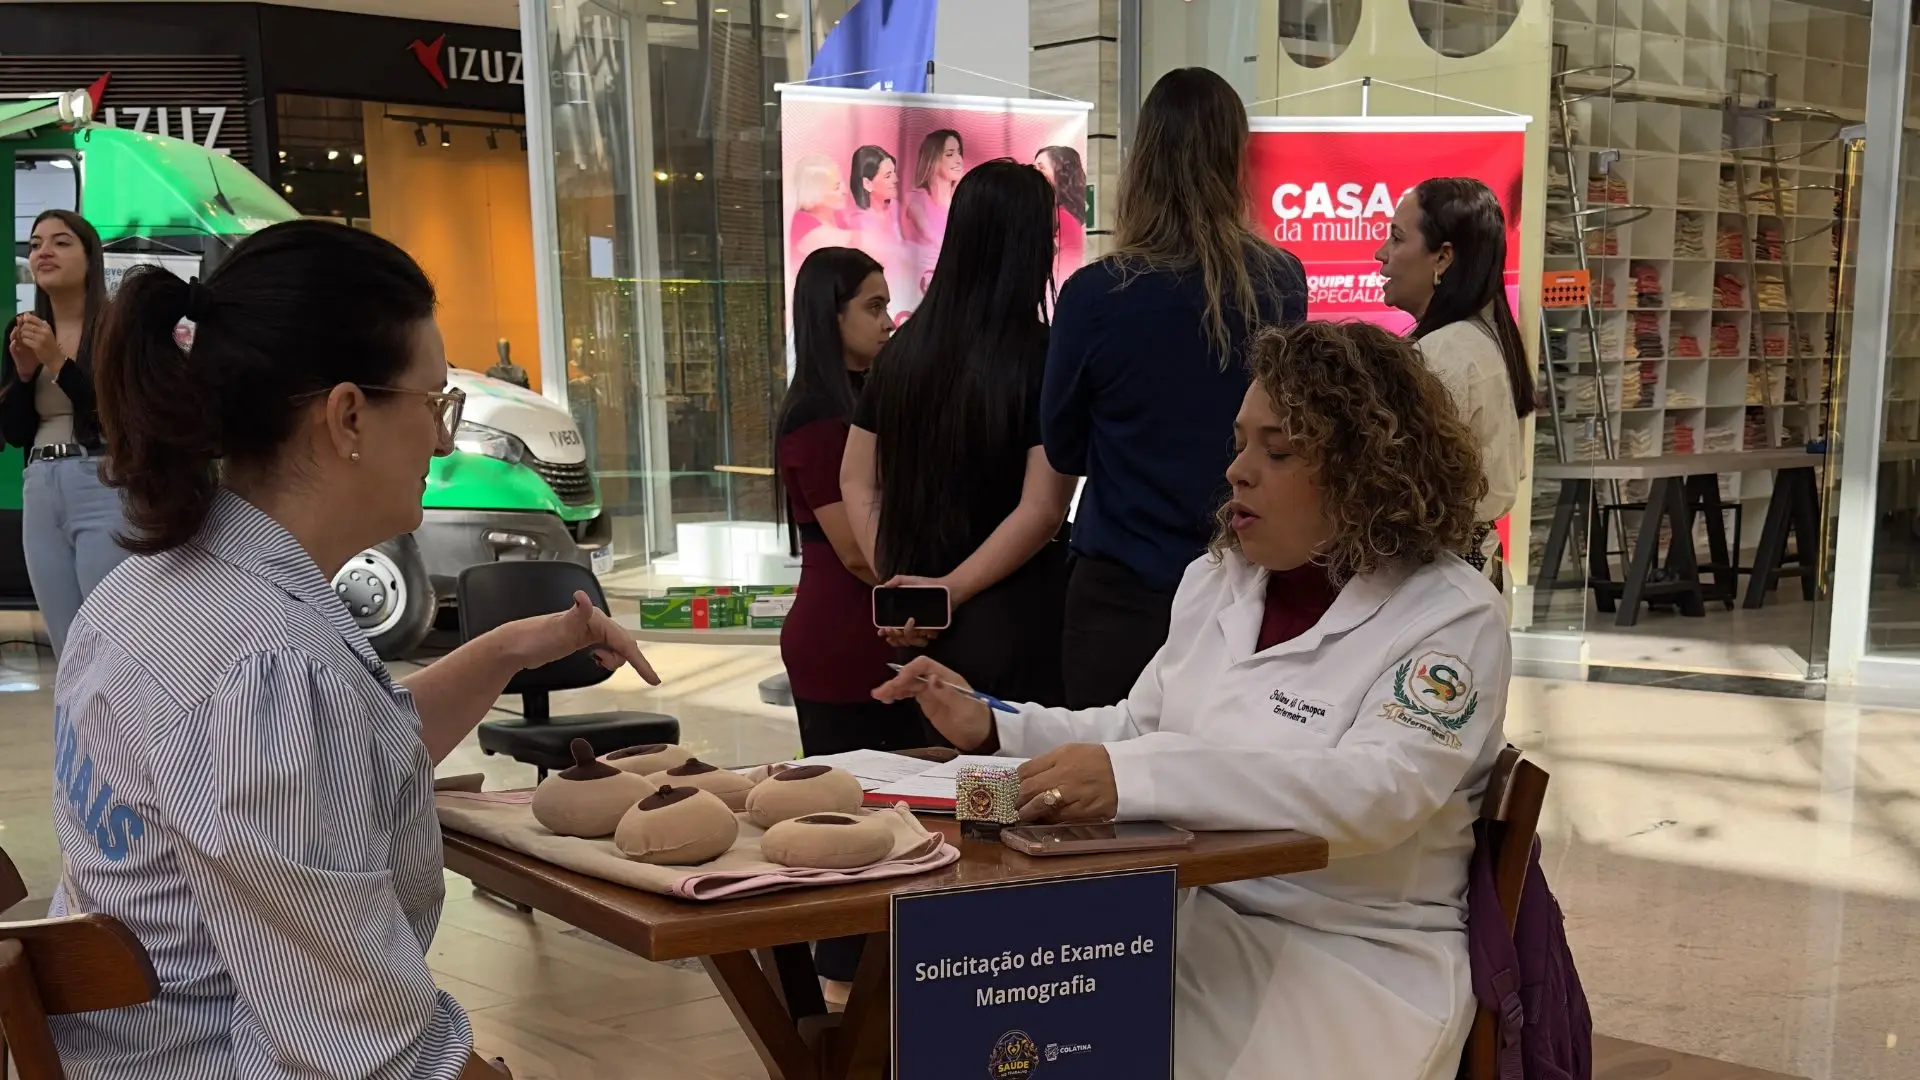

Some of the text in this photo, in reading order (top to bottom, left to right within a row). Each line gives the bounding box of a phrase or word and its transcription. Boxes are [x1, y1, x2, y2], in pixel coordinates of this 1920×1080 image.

[1272, 182, 1395, 219] CASA
[1274, 217, 1301, 242] da
[1306, 274, 1355, 290] QUIPE
[915, 935, 1154, 982] Solicitação de Exame de
[976, 974, 1096, 1007] Mamografia
